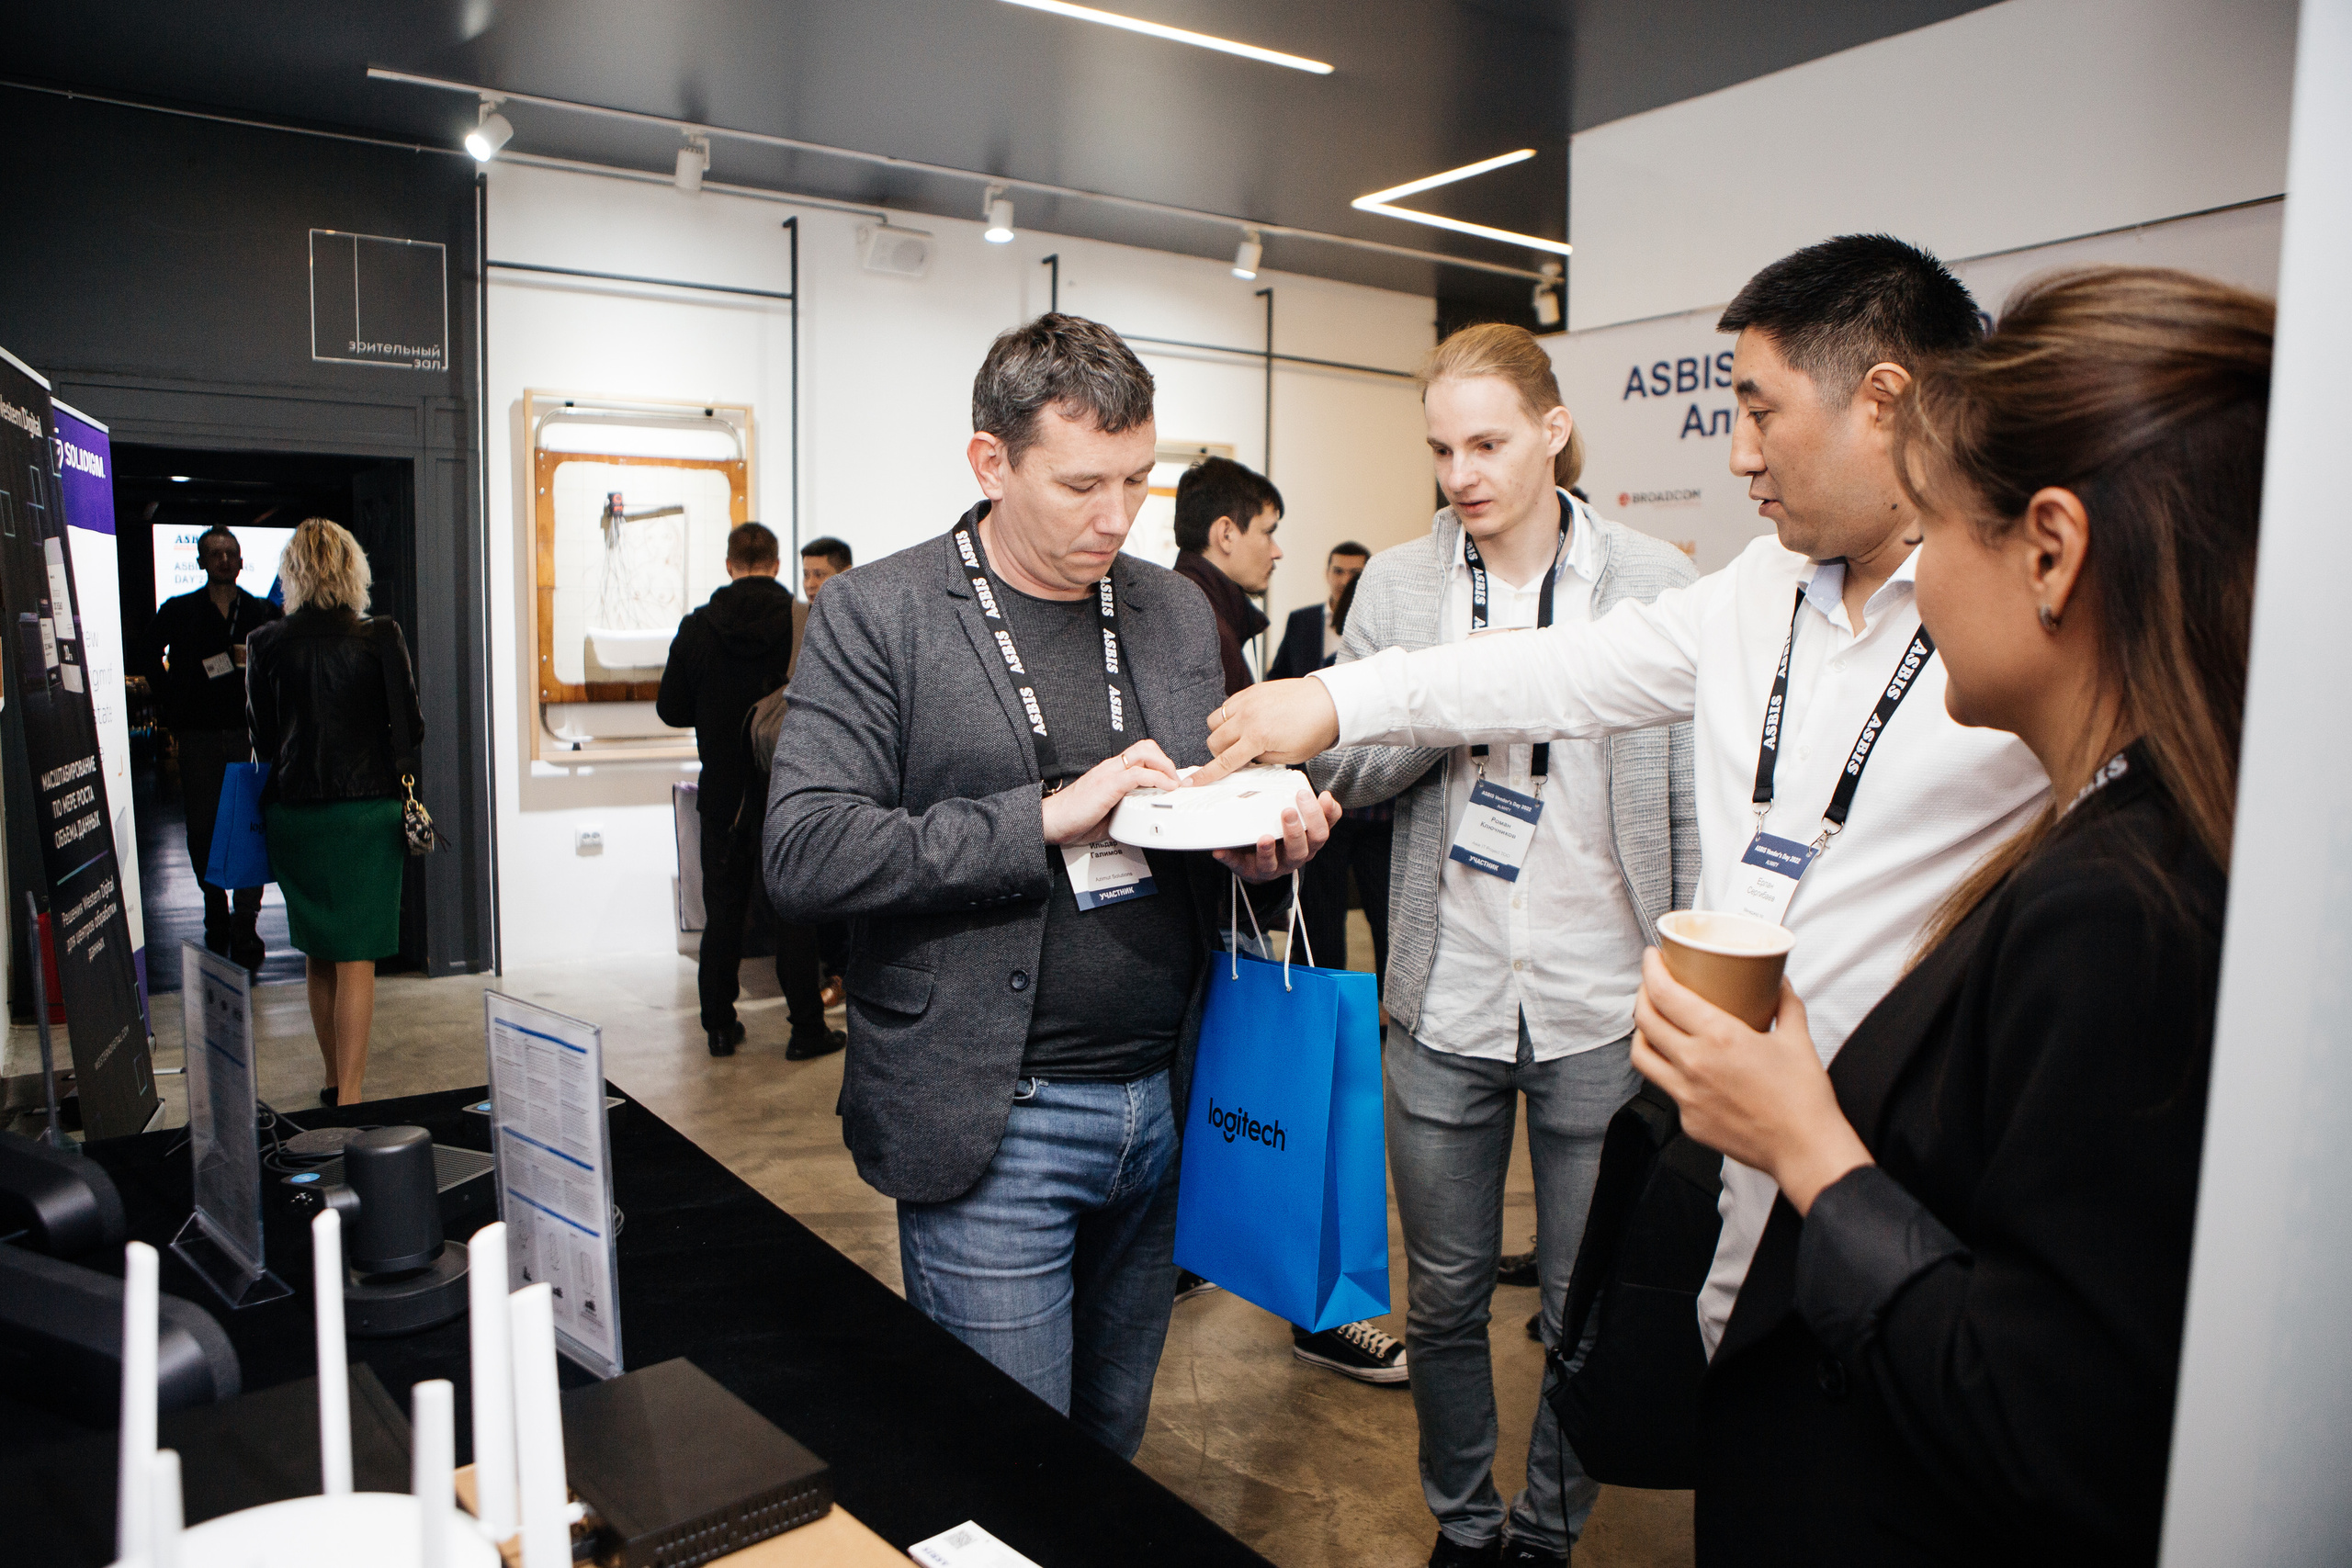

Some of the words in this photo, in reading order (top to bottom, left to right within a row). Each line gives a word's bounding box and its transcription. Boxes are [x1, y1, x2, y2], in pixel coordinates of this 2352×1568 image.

[348, 340, 441, 357] зрительный
[413, 358, 441, 370] зал
[1623, 351, 1735, 400] ASBIS
[20, 406, 43, 439] Digital
[64, 442, 105, 479] SOLIDIGM
[1633, 489, 1702, 503] BROADCOM
[175, 535, 199, 544] ASB
[956, 530, 980, 569] ASBIS
[972, 577, 1001, 619] ASBIS
[1100, 576, 1114, 617] ASBIS
[1473, 567, 1487, 606] ASBIS
[994, 630, 1025, 674] ASBIS
[1103, 628, 1119, 674] ASBIS
[1887, 637, 1928, 701] ASBIS
[1019, 686, 1047, 737] ASBIS
[1108, 684, 1124, 732] ASBIS
[1763, 694, 1782, 750] ASBIS
[1847, 713, 1883, 776] ASBIS
[40, 754, 96, 792] МАСШТАБИРОВАНИЕ
[51, 798, 62, 818] ПО
[62, 791, 77, 814] МЕРЕ
[77, 784, 95, 807] РОСТА
[1481, 790, 1494, 799] ASBIS
[1512, 801, 1521, 809] Day
[76, 810, 101, 840] ДАННЫХ
[1480, 821, 1517, 840] Ключников
[1491, 817, 1511, 829] Роман
[1089, 840, 1118, 850] Ильдар
[1090, 849, 1123, 859] Галимов
[1782, 853, 1791, 862] Day
[1790, 855, 1802, 864] 2022
[1469, 855, 1499, 871] УЧАСТНИК
[1099, 886, 1135, 900] УЧАСТНИК
[1208, 1097, 1286, 1152] logitech
